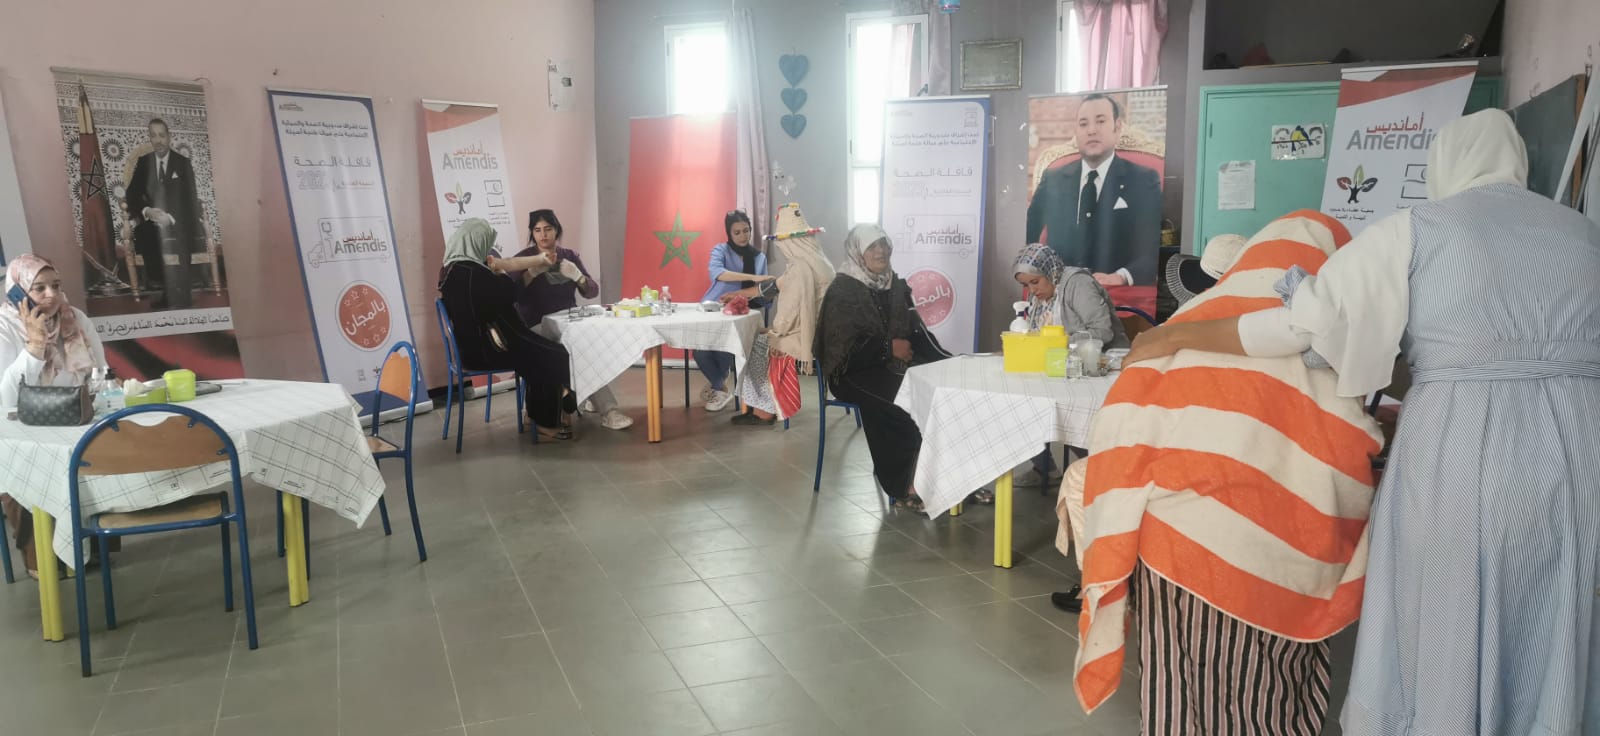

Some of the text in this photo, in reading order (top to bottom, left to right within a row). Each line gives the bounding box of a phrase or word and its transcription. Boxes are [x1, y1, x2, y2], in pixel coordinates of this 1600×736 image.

[1366, 111, 1425, 135] أمانديس
[1346, 128, 1438, 150] Amendi
[442, 152, 499, 171] Amendis
[334, 240, 388, 255] Amendis
[342, 230, 375, 245] أمانديس
[915, 232, 973, 245] Amendis
[911, 284, 951, 307] بالمجا
[345, 299, 386, 336] بالمجان
